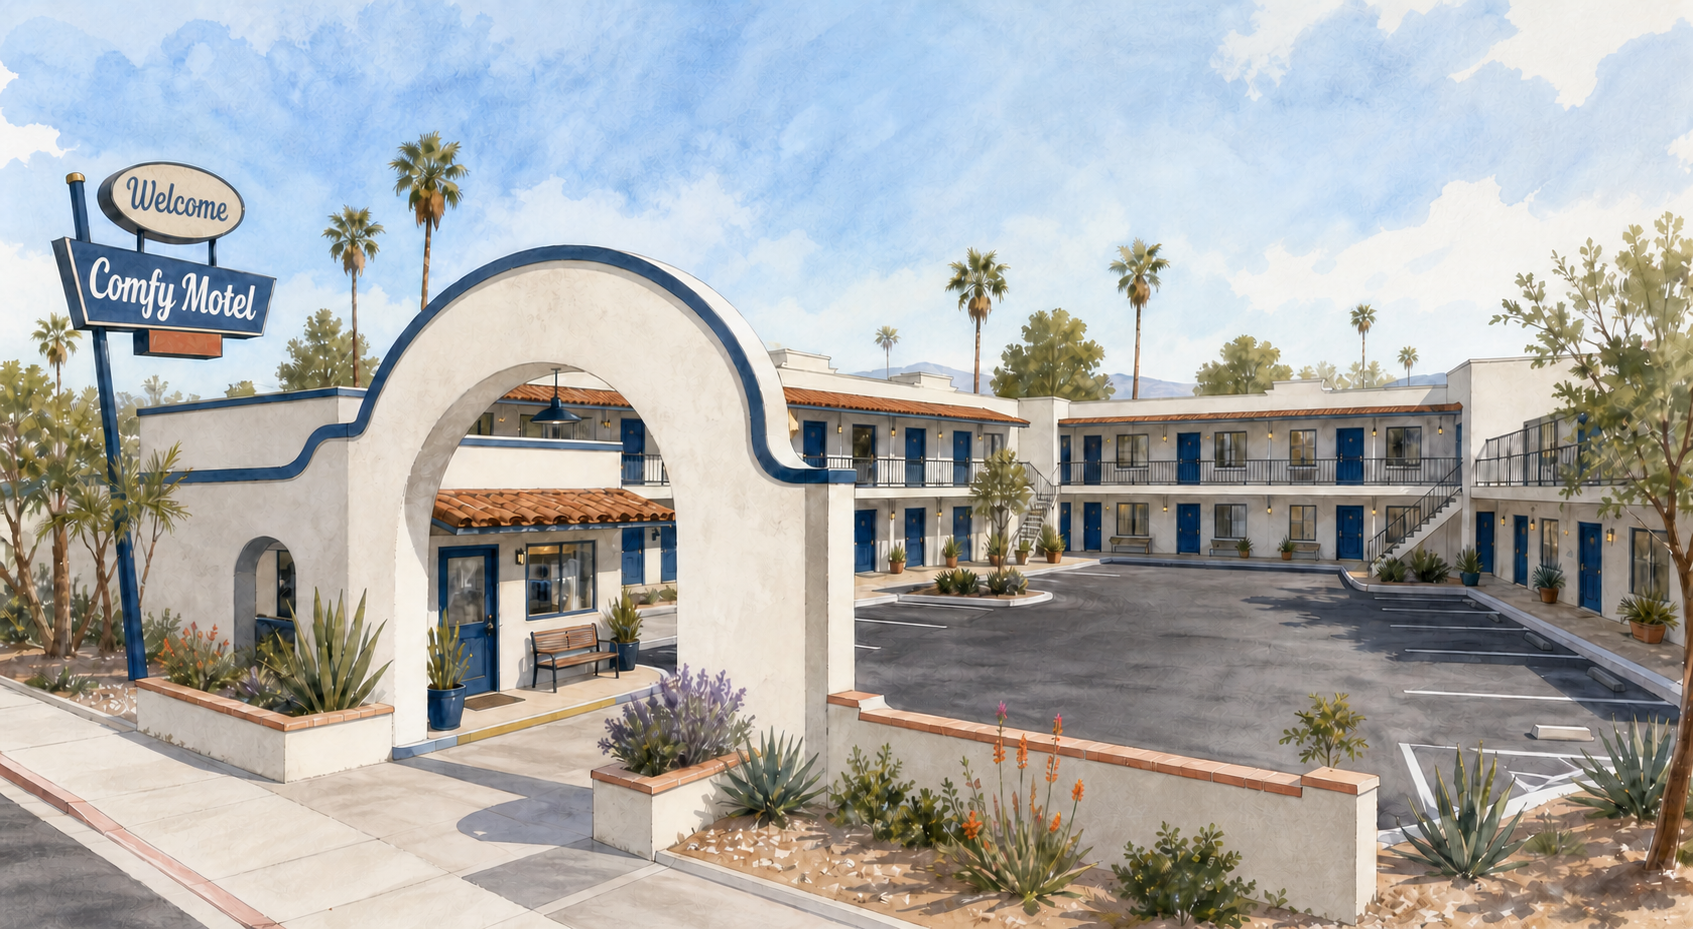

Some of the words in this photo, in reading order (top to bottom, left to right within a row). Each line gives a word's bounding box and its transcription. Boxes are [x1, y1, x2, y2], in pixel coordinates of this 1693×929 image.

[126, 176, 229, 222] Welcome
[89, 256, 176, 321] Comfy
[181, 272, 257, 320] Motel
